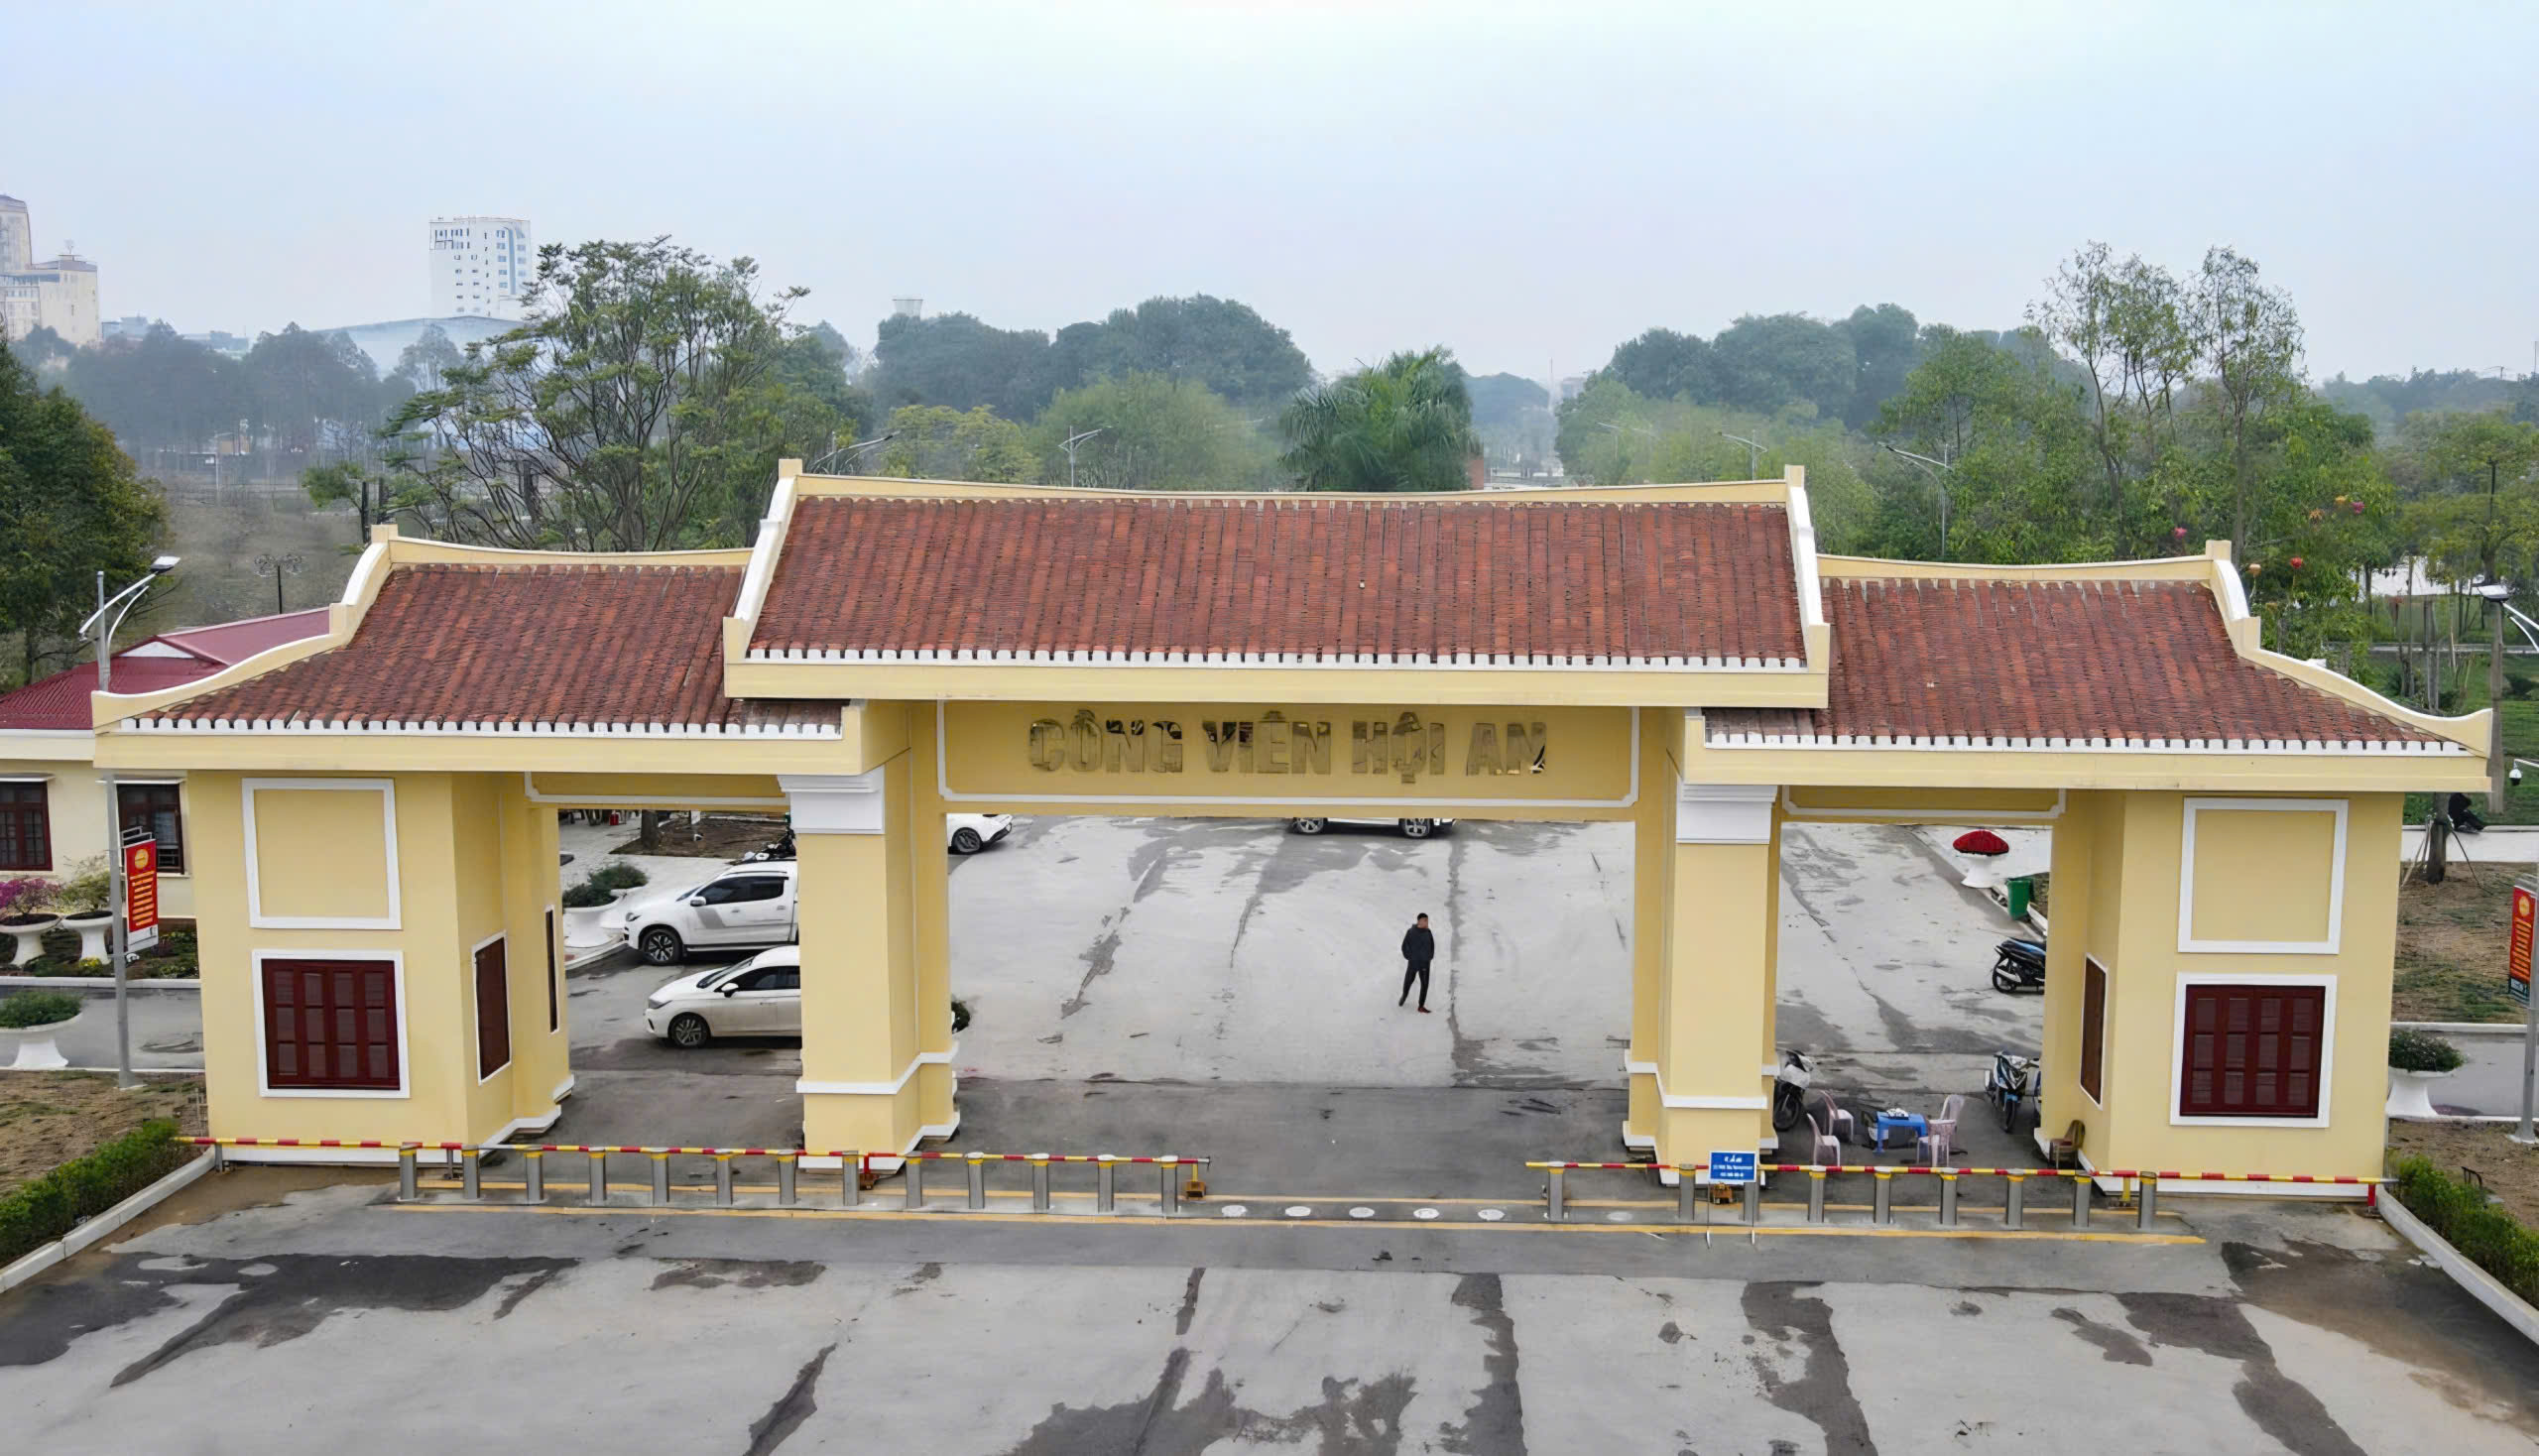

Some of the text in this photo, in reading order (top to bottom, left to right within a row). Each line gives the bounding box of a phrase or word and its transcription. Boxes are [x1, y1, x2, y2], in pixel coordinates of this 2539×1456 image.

[1029, 709, 1547, 784] CÔNG VIÊN HỘI AN
